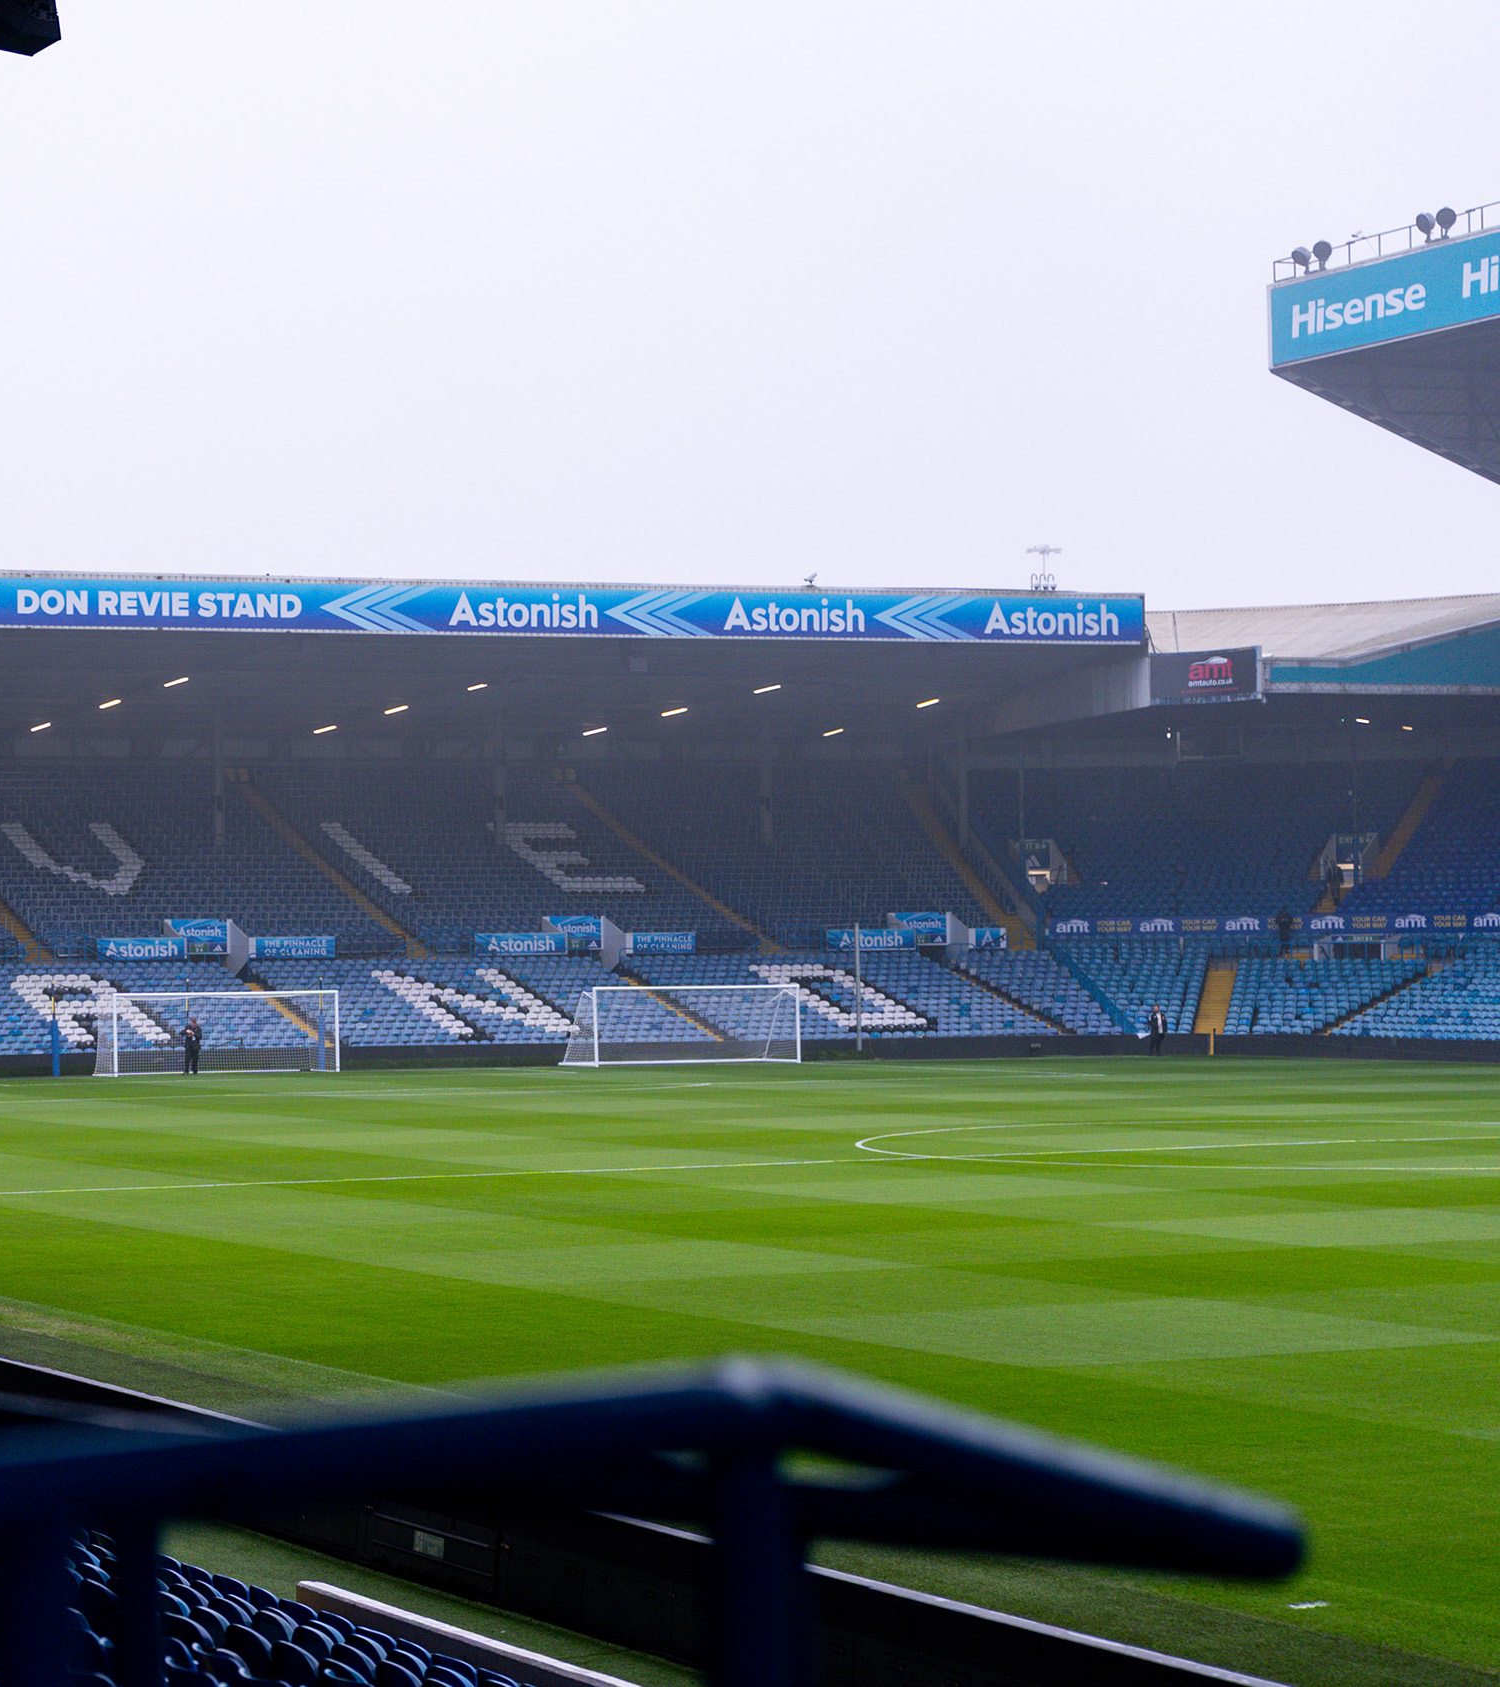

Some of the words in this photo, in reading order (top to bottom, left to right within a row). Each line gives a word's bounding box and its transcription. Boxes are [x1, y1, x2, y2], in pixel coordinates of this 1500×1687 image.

[1292, 283, 1426, 338] Hisense
[17, 590, 88, 615] DON
[98, 591, 190, 616] REVIE
[198, 593, 302, 618] STAND
[449, 591, 598, 628] Astonish
[723, 596, 865, 633] Astonish
[984, 601, 1119, 636] Astonish
[1188, 657, 1233, 680] amt
[1188, 678, 1233, 687] amtauto.co.uk
[1055, 919, 1090, 933] amt
[1139, 918, 1174, 932] amt
[1225, 917, 1260, 931] amt
[1310, 916, 1345, 930] amt
[1394, 914, 1428, 929] amt
[1473, 913, 1500, 928] am
[180, 926, 221, 937] Astonish
[105, 941, 178, 957] Astonish
[265, 940, 280, 948] THE
[283, 939, 327, 947] PINNACLE
[488, 935, 555, 952] Astonish
[264, 948, 277, 956] OF
[280, 948, 327, 956] CLEANING
